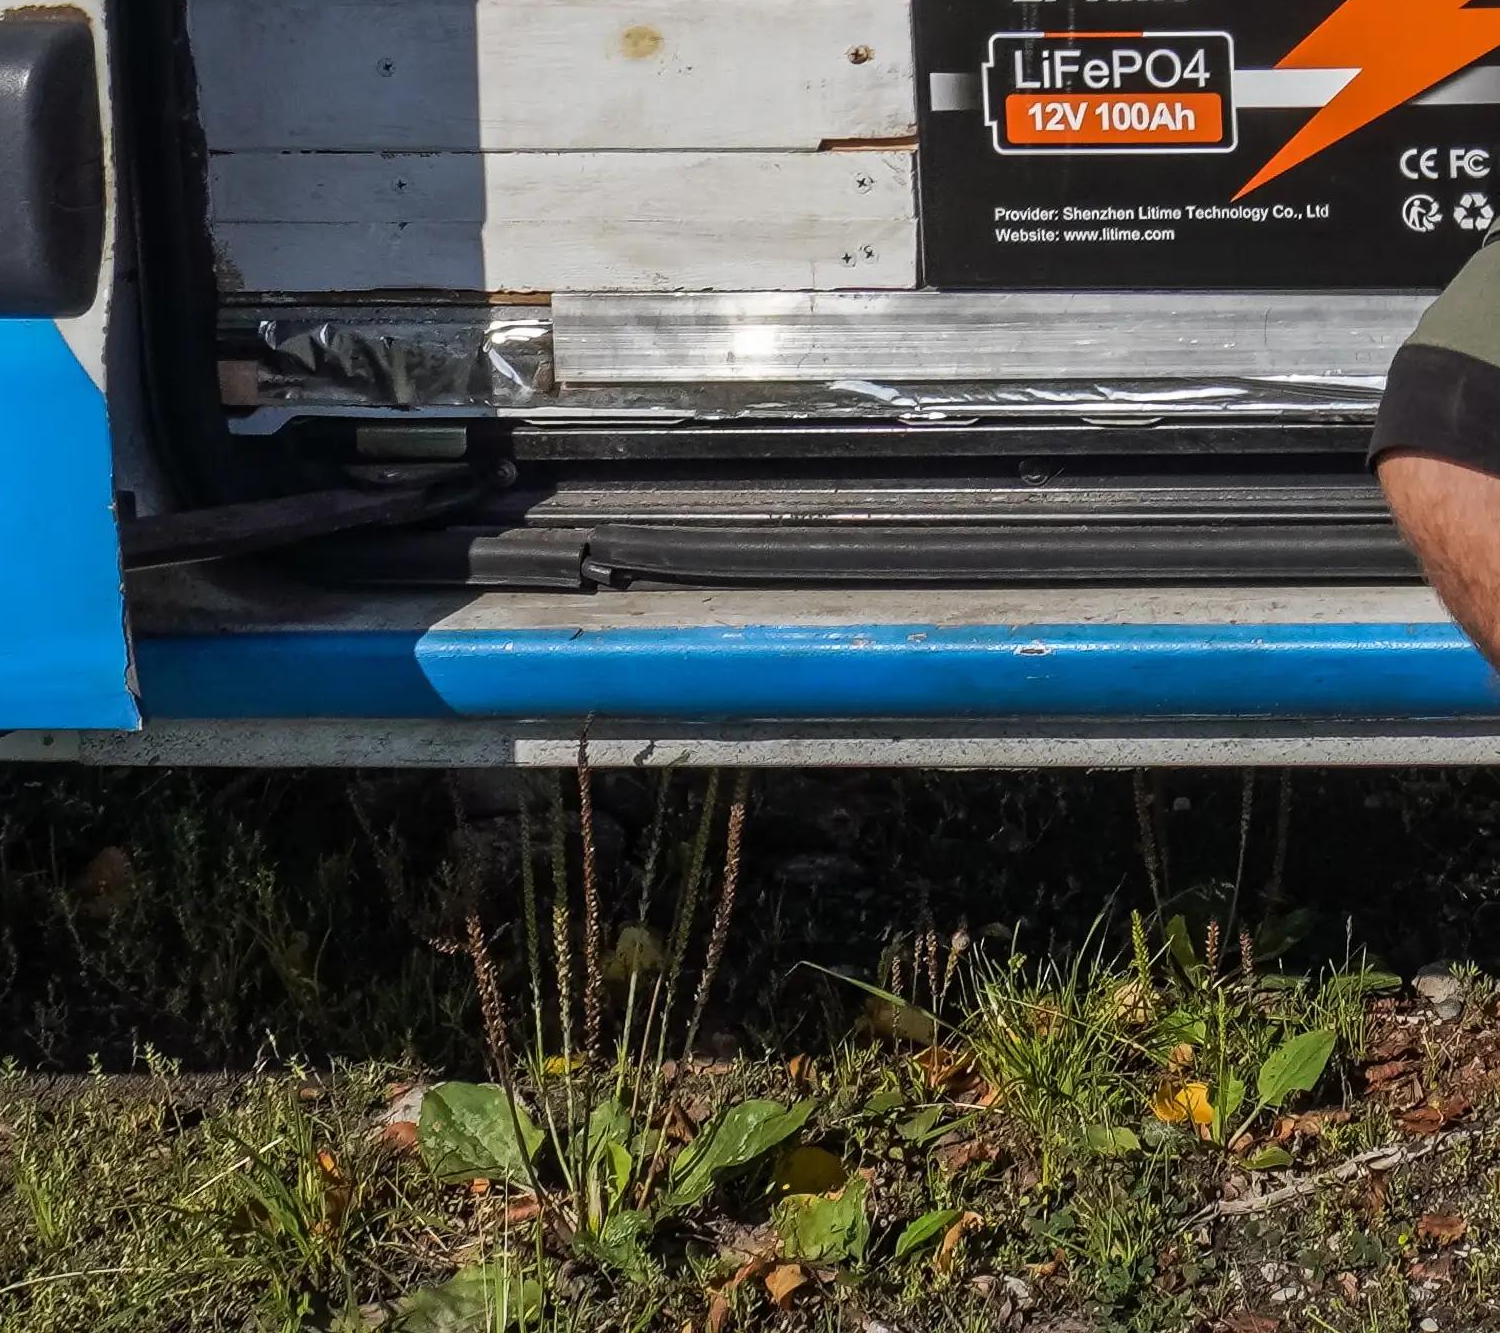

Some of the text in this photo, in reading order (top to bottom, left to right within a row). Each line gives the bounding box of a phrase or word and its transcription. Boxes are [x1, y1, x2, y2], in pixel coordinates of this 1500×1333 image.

[1014, 49, 1210, 89] LiFePO4
[1027, 102, 1195, 132] 12V 100Ah
[1401, 149, 1439, 179] CE
[995, 204, 1329, 224] Provider: Shenzhen Litime Technology Co., Ltd
[995, 227, 1175, 243] Website: www.litime.com
